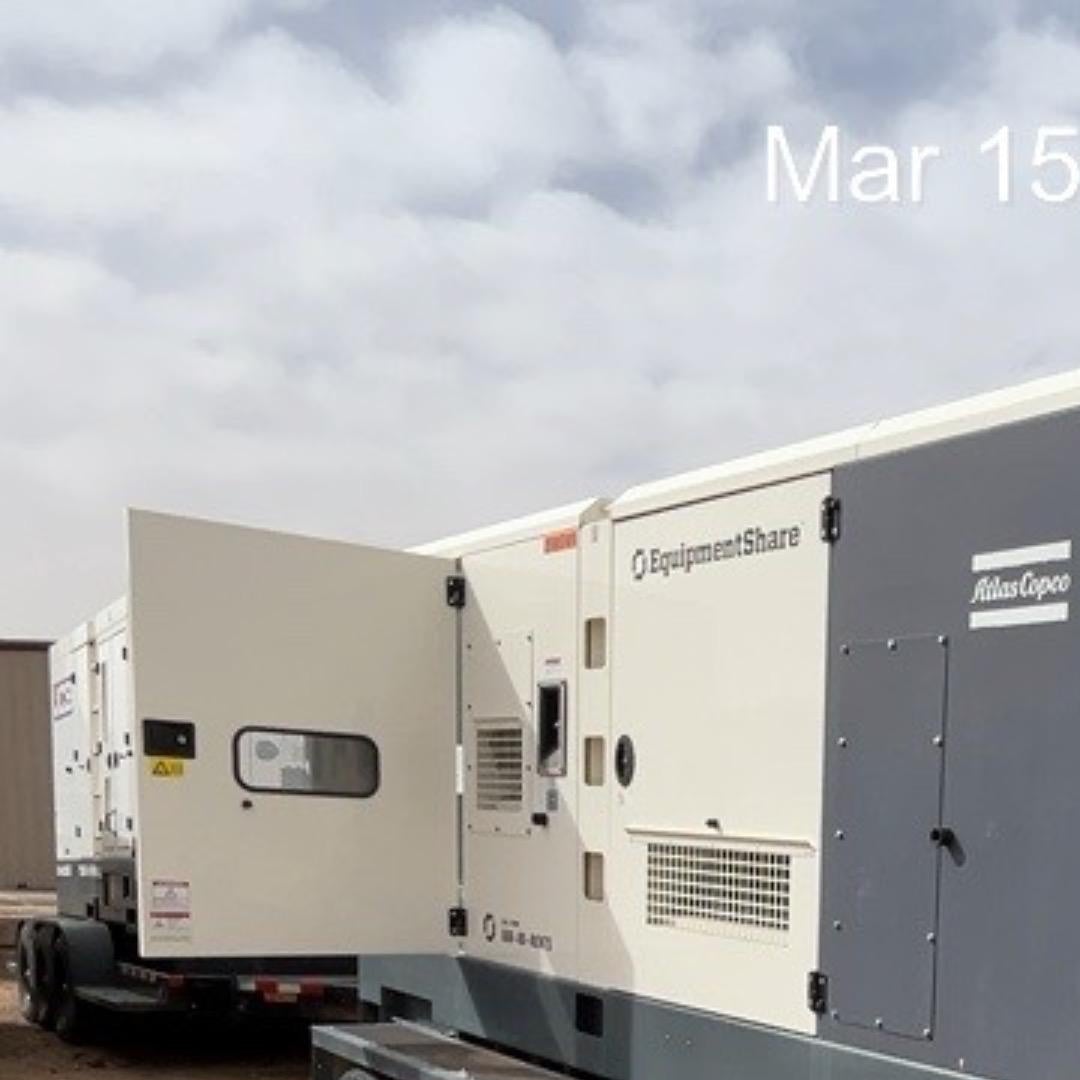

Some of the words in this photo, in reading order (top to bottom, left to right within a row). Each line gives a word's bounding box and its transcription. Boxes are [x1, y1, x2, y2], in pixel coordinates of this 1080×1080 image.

[650, 526, 800, 577] EquipmentShare
[969, 575, 1018, 604] Atlas
[1019, 571, 1071, 601] Copco
